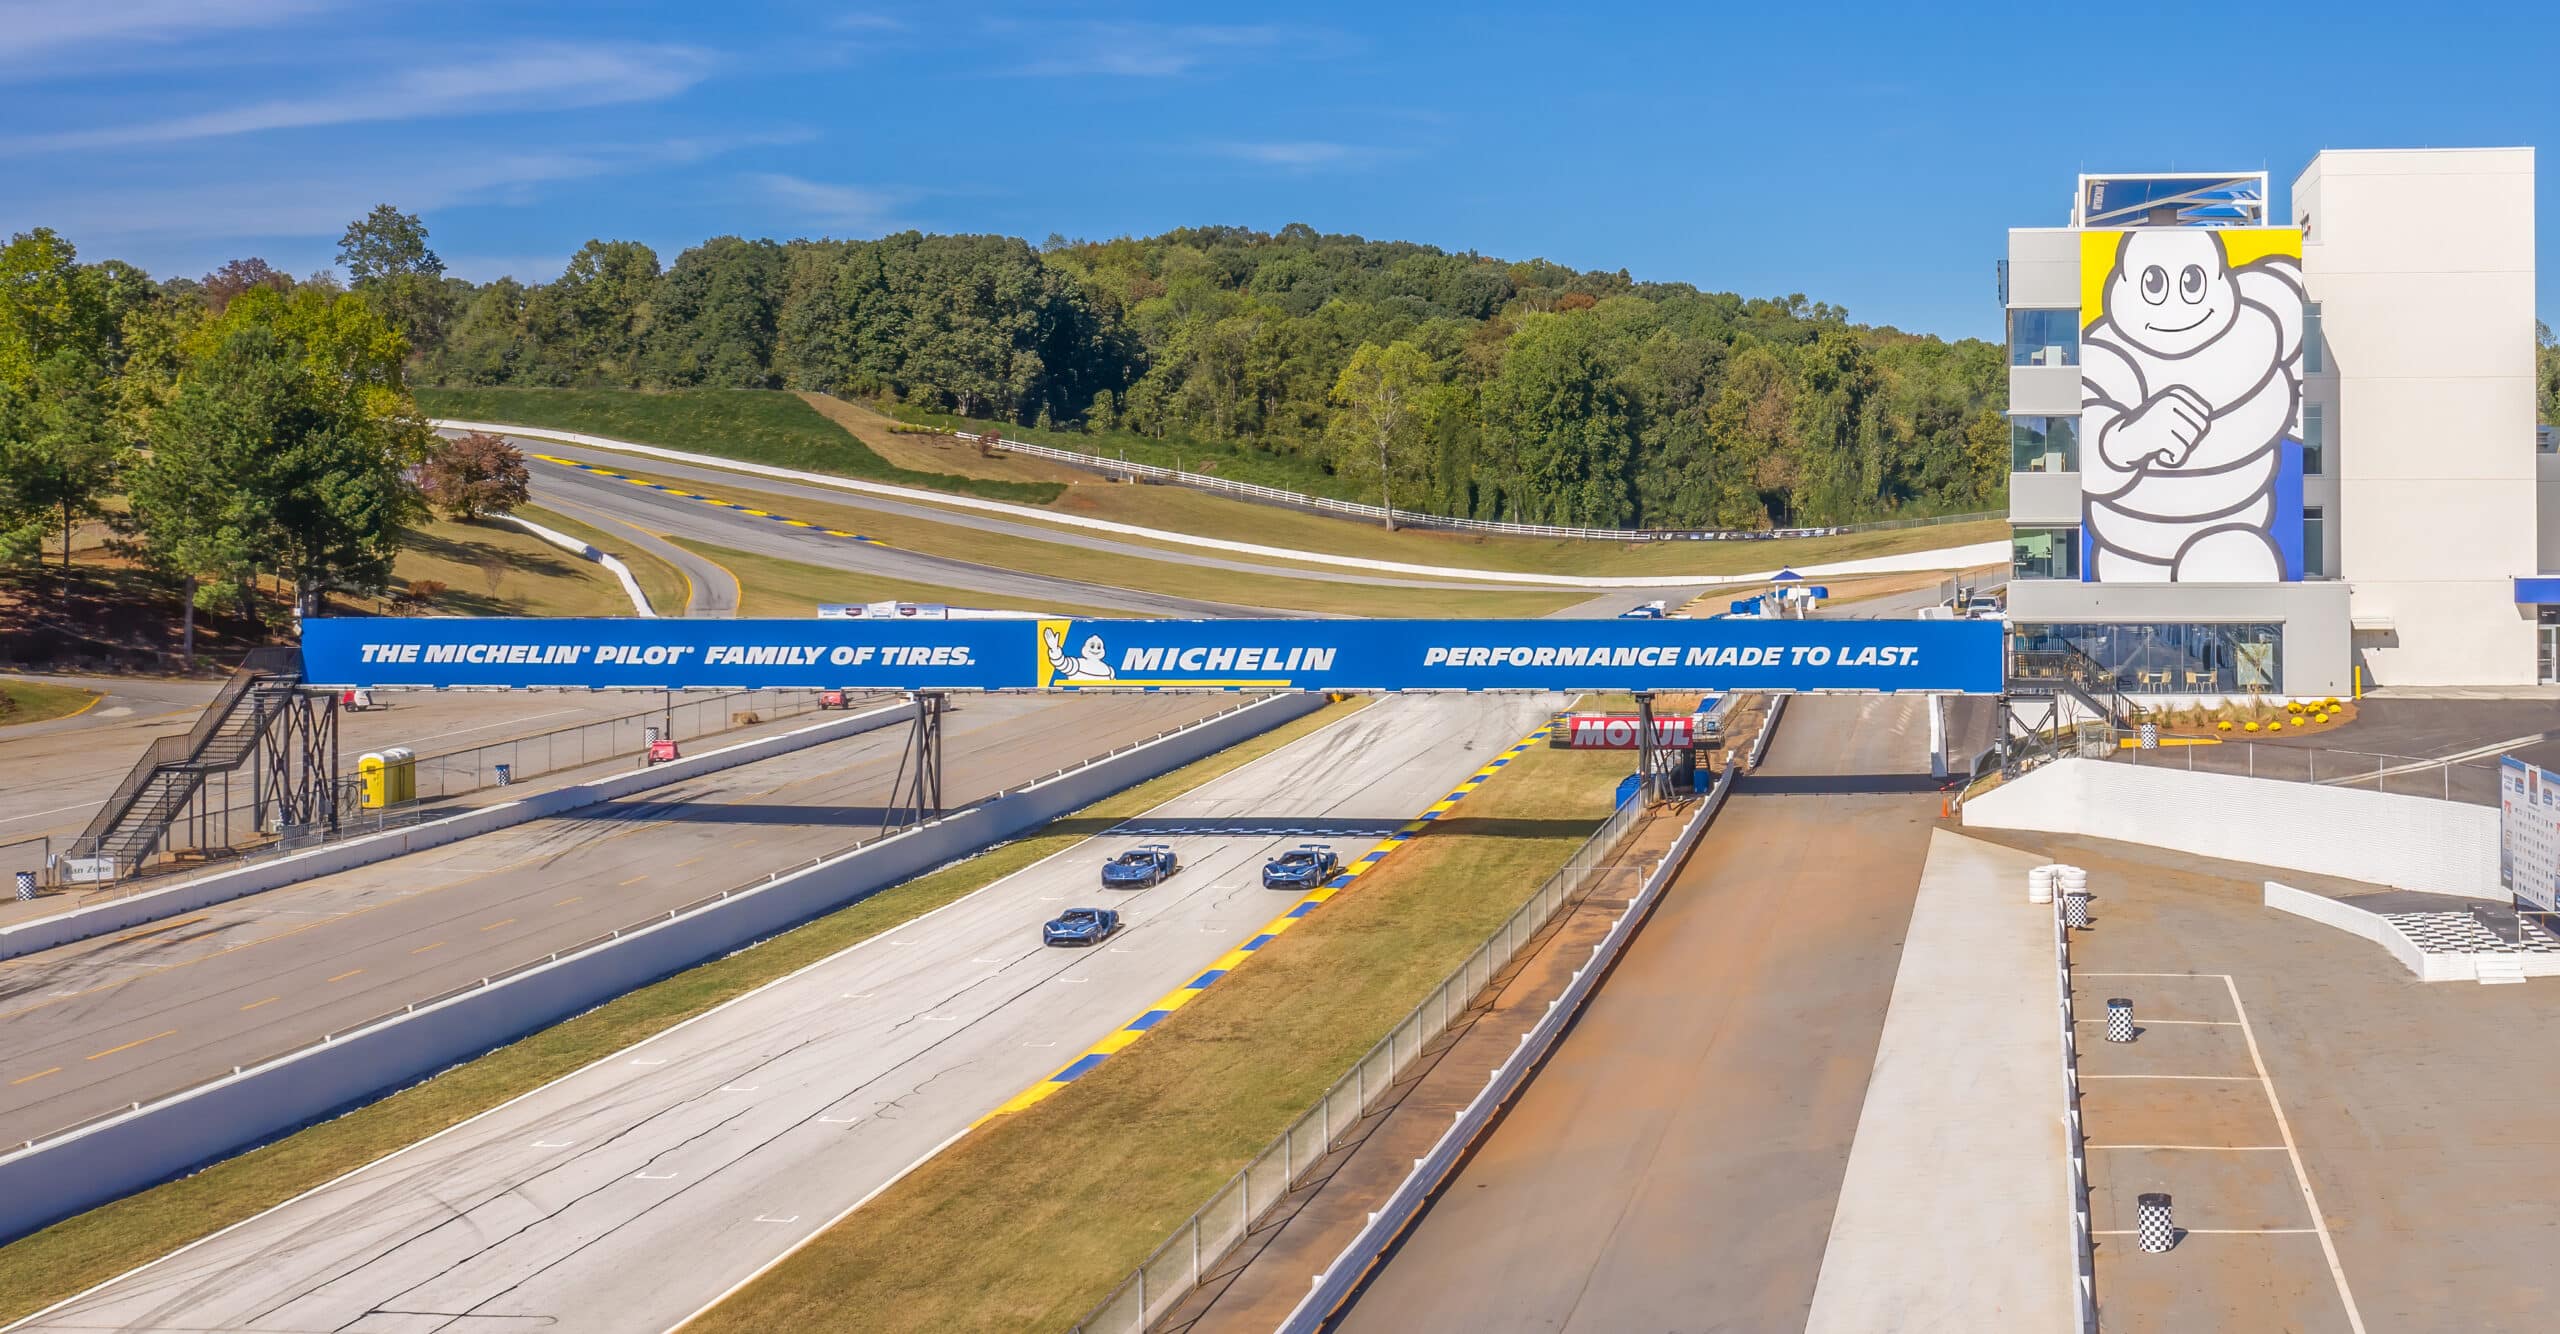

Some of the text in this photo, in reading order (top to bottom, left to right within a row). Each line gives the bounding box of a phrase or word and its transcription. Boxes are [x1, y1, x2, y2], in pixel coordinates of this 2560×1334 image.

[362, 644, 421, 663] THE
[703, 646, 828, 665] FAMILY
[830, 646, 876, 666] OF
[880, 647, 976, 666] TIRES.
[1121, 647, 1337, 671] MICHELIN
[1423, 646, 1920, 667] PERFORMANCE MADE TO LAST.
